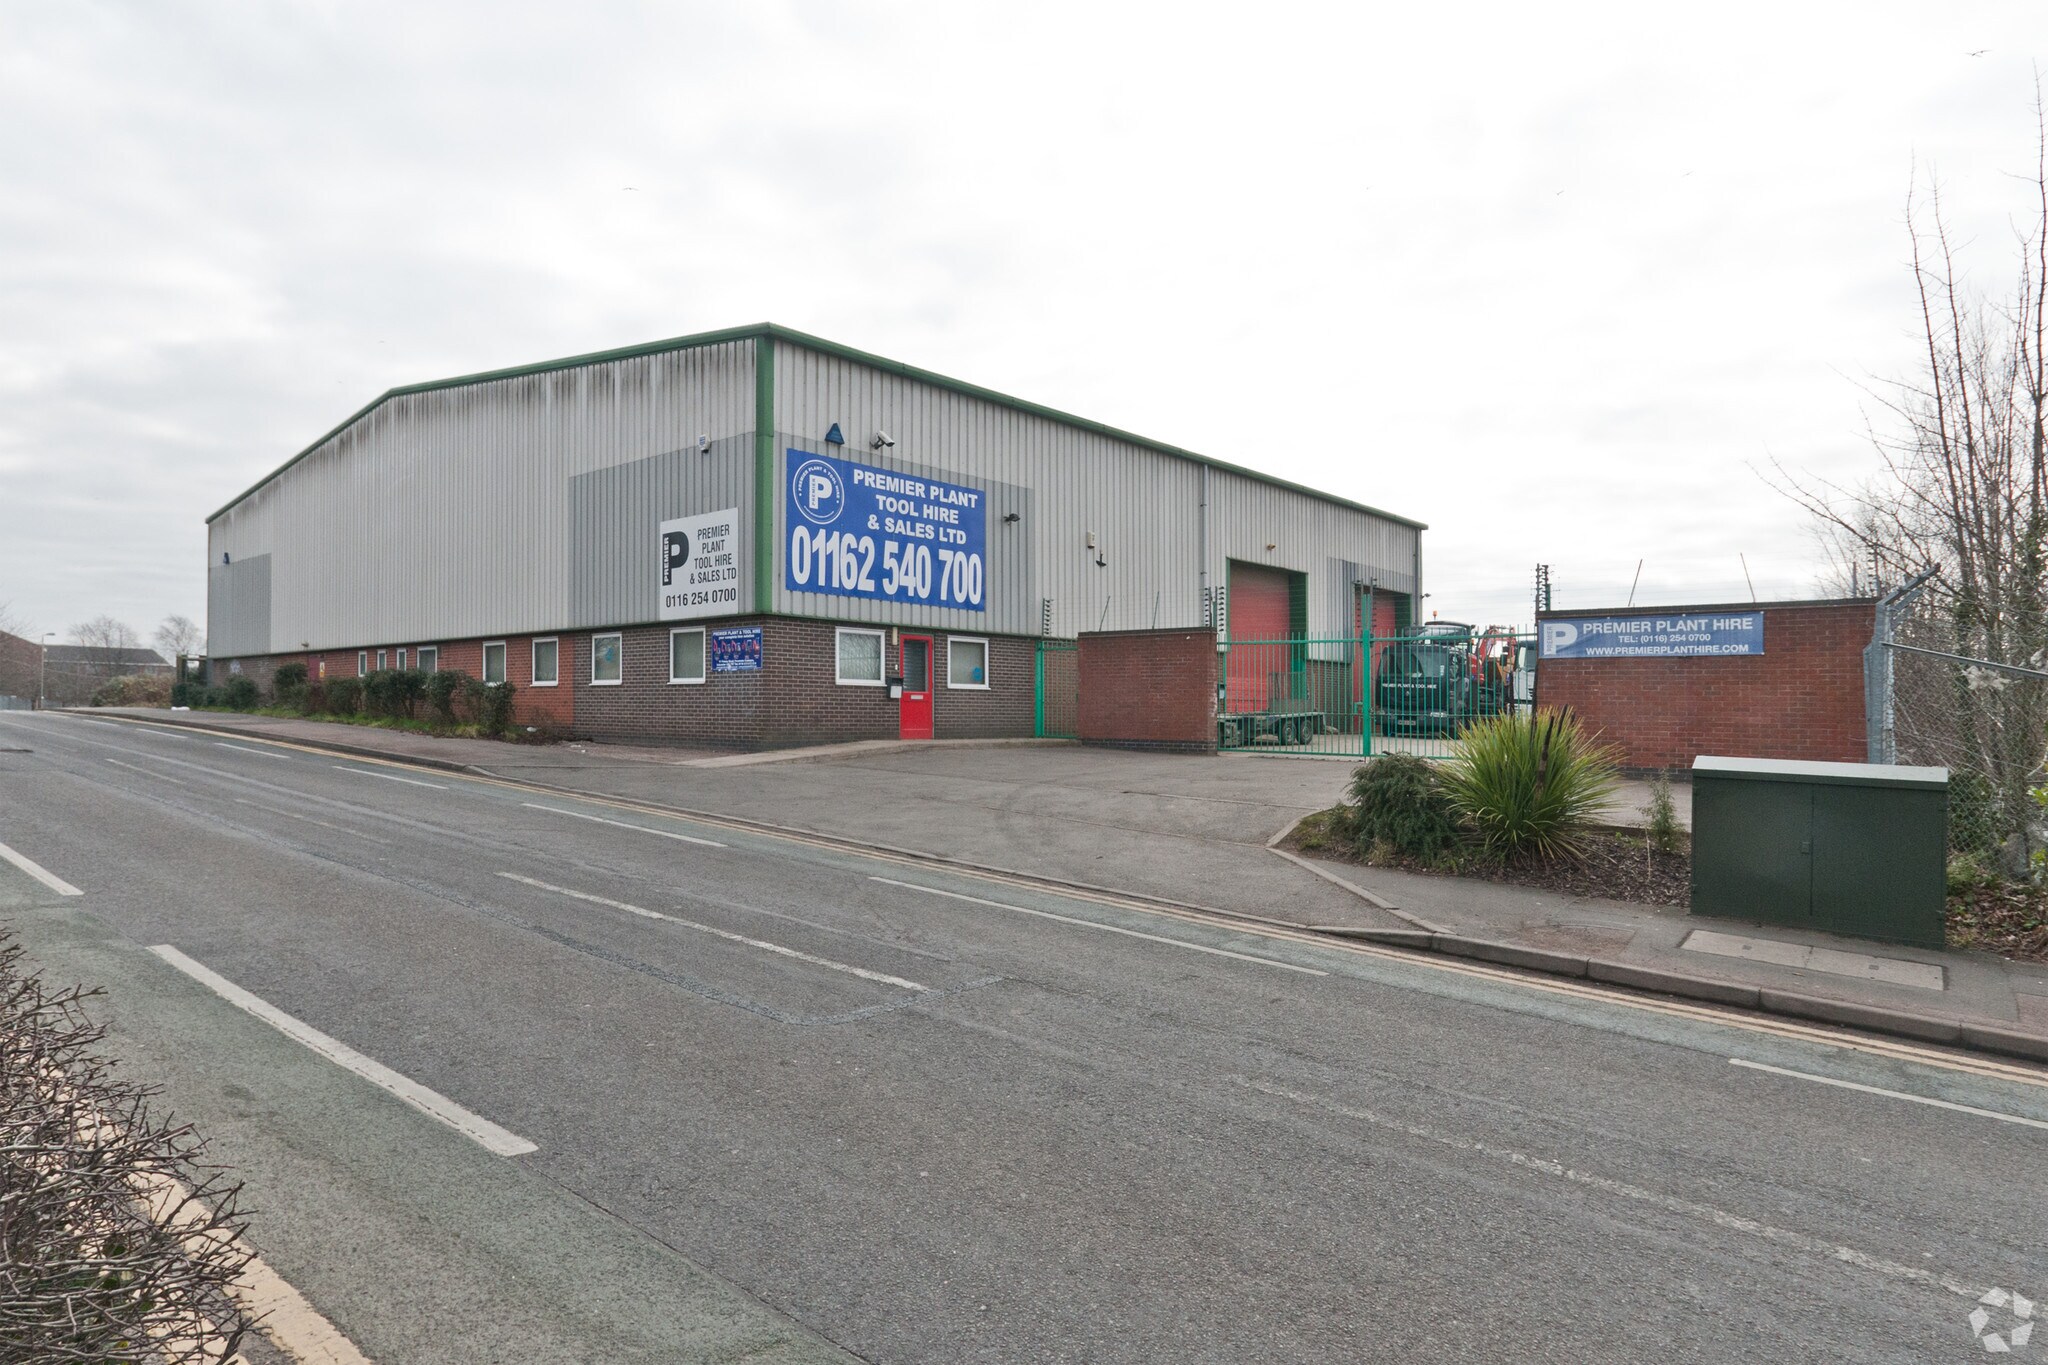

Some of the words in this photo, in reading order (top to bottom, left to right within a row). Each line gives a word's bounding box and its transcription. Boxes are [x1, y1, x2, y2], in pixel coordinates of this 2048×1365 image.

[809, 474, 832, 509] P
[853, 468, 926, 498] PREMIER
[929, 485, 978, 508] PLANT
[875, 494, 919, 517] TOOL
[923, 504, 959, 524] HIRE
[697, 524, 730, 540] PREMIER
[867, 514, 880, 530] &
[884, 517, 935, 540] SALES
[939, 527, 967, 545] LTD
[702, 540, 725, 554] PLANT
[662, 531, 689, 586] P
[694, 556, 713, 569] TOOL
[715, 553, 732, 566] HIRE
[791, 525, 875, 592] 01162
[882, 540, 932, 599] 540
[938, 548, 983, 605] 700
[690, 573, 695, 584] &
[698, 569, 720, 584] SALES
[722, 567, 737, 580] LTD
[666, 593, 688, 608] 0116
[691, 591, 709, 605] 254
[712, 588, 736, 603] 0700
[1583, 622, 1651, 634] PREMIER
[1656, 619, 1709, 632] PLANT
[1713, 618, 1753, 630] HIRE
[1544, 623, 1577, 655] P
[1618, 635, 1638, 643] TEL:
[1640, 634, 1667, 644] (0116)
[1669, 634, 1686, 642] 254
[1688, 633, 1711, 641] 0700
[1586, 644, 1749, 655] WWW.PREMIERPLANTHIRE.COM
